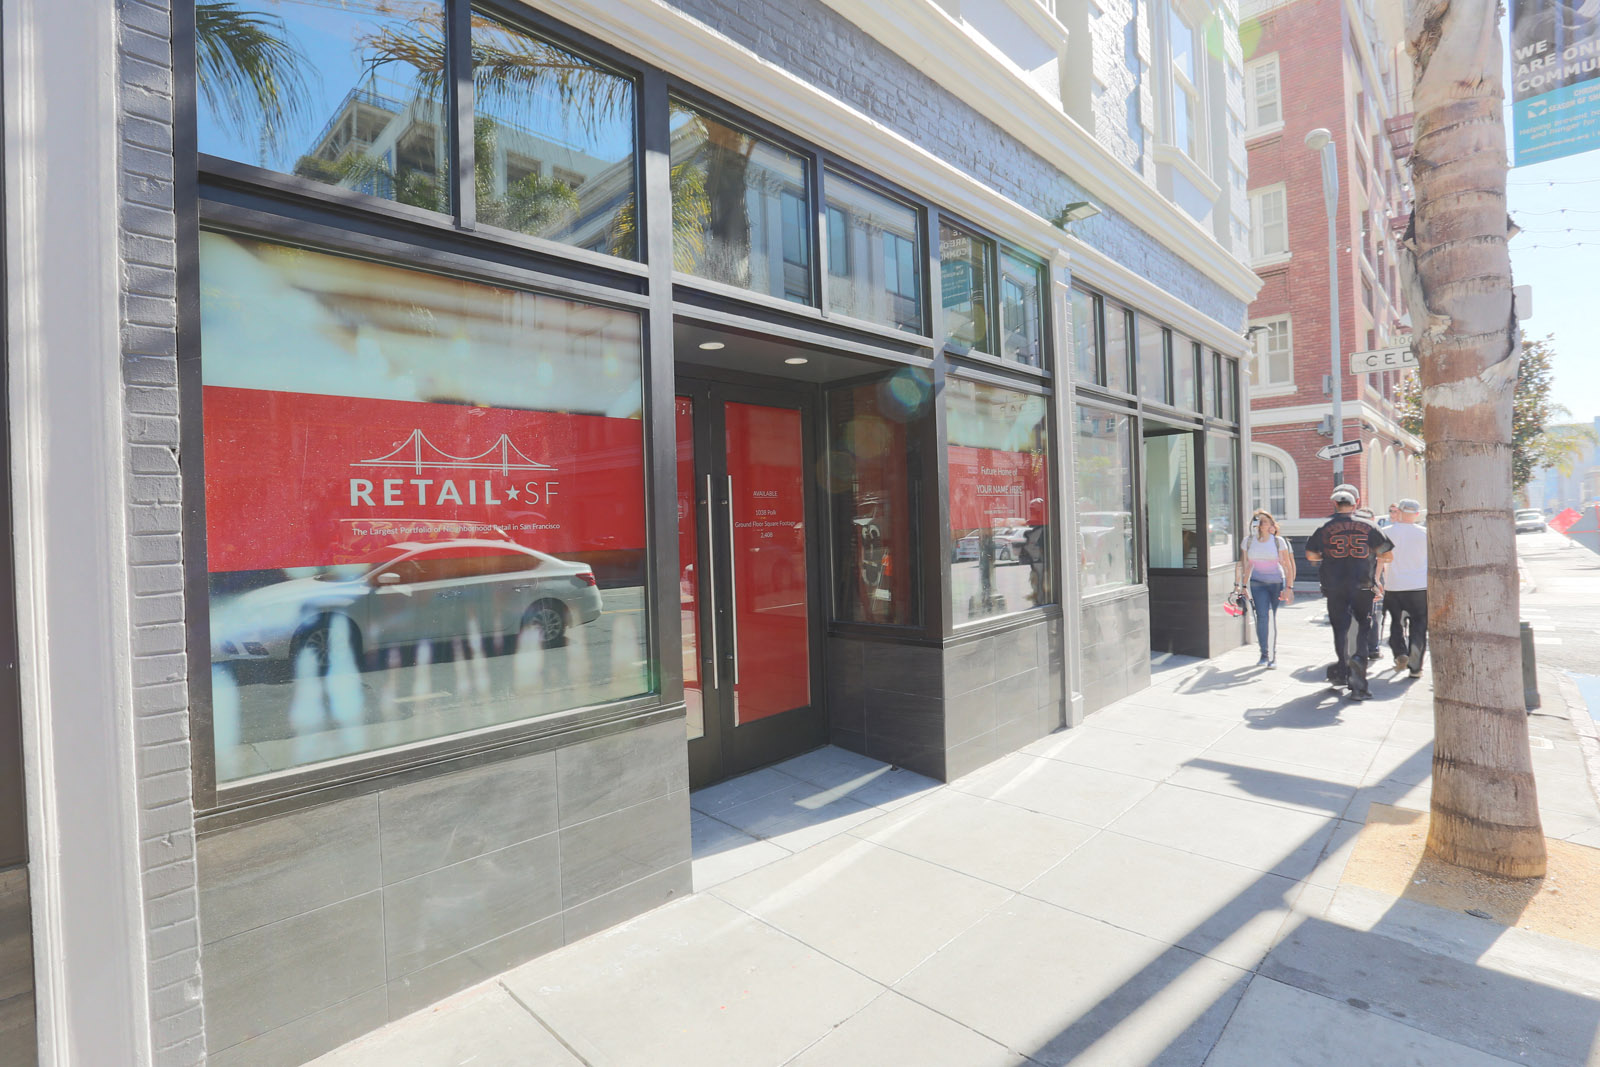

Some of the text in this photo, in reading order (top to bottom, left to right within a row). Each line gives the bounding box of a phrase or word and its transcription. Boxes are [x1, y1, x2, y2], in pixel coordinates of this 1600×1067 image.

[1515, 40, 1548, 60] WE
[1517, 53, 1556, 77] ARE
[981, 466, 997, 475] Future
[997, 467, 1012, 476] Home
[350, 478, 560, 507] RETAIL SF
[976, 484, 1023, 494] YOUR NAME HERE
[352, 528, 368, 536] The
[370, 527, 398, 537] Largest
[400, 526, 432, 534] Portfolio
[443, 524, 491, 534] Neighborhood
[1329, 534, 1370, 559] 35
